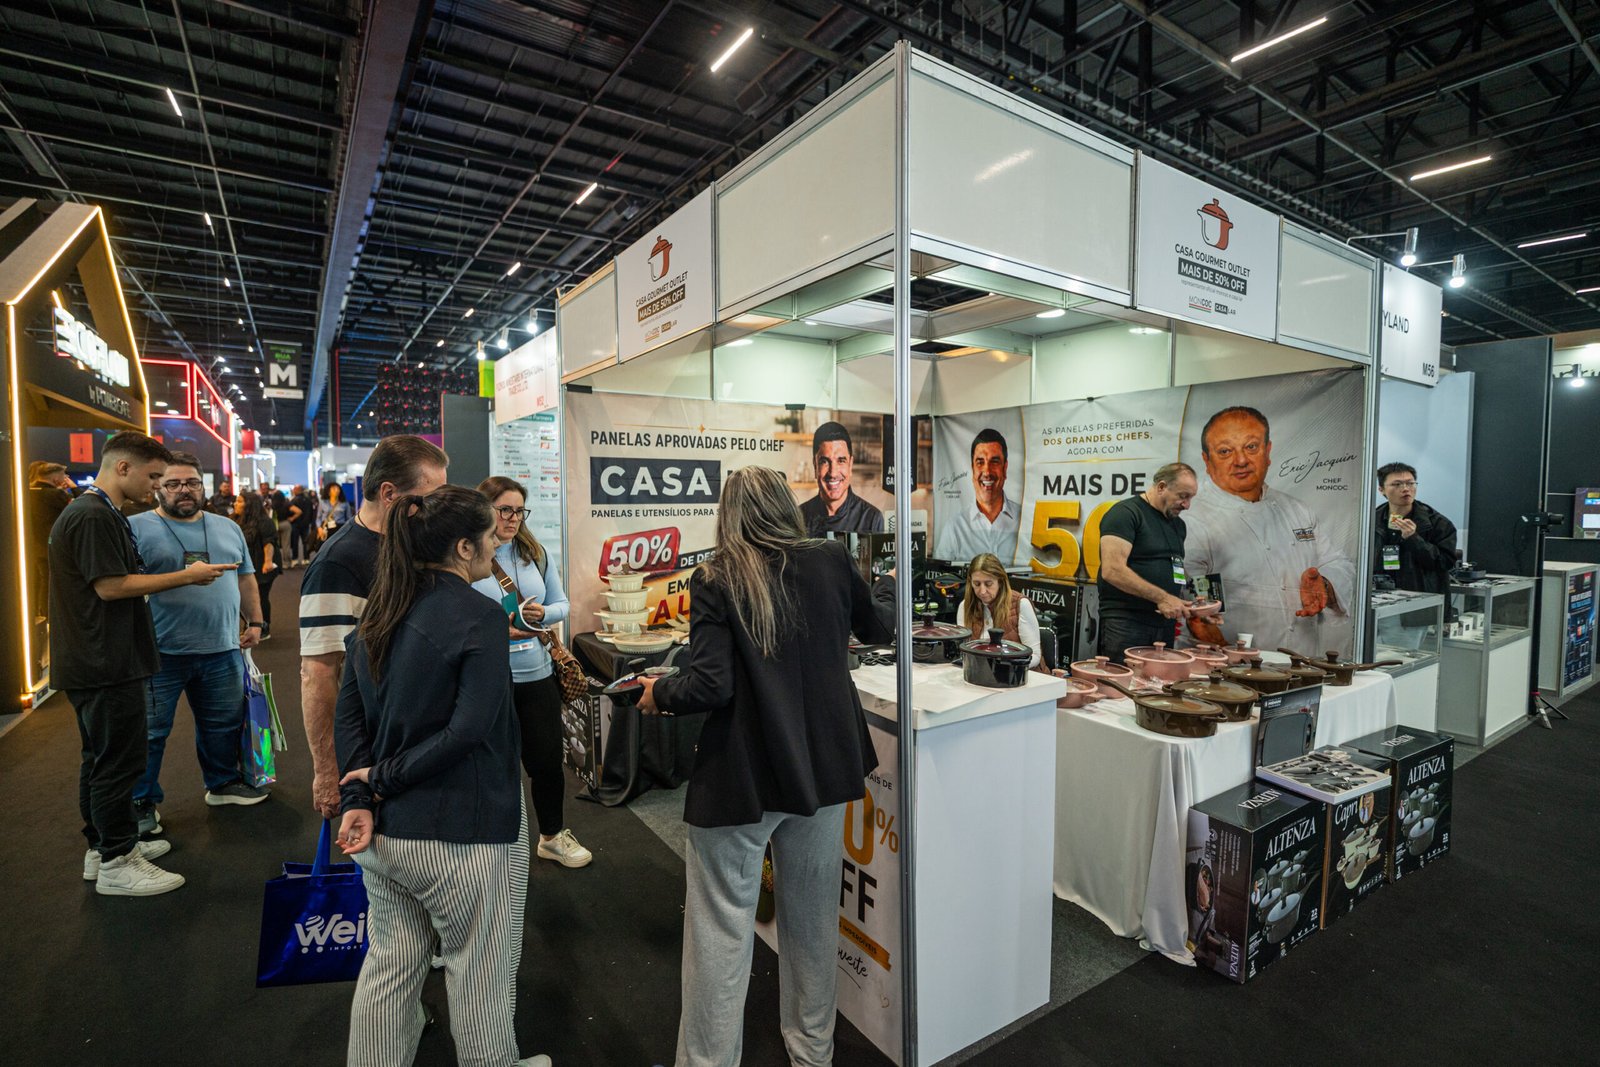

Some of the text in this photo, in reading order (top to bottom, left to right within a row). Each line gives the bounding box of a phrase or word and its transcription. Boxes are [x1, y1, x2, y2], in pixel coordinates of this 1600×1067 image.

[1174, 243, 1250, 278] CASA GOURMET OUTLET
[1180, 261, 1245, 292] MAIS DE 50% OFF
[636, 271, 688, 307] CASA GOURMET OUTLET
[640, 305, 652, 319] MAIS
[652, 301, 660, 312] DE
[660, 295, 672, 309] 50%
[672, 288, 684, 302] OFF
[270, 363, 297, 387] M
[1422, 362, 1435, 378] M56
[1042, 419, 1154, 436] AS PANELAS PREFERIDAS
[590, 430, 785, 452] PANELAS APROVADAS PELO CHEF
[1043, 438, 1062, 446] DOS
[1065, 434, 1112, 445] GRANDES
[1067, 445, 1124, 456] AGORA COM
[1279, 451, 1357, 484] Eric Jacquin
[600, 465, 713, 496] CASA
[1043, 473, 1146, 496] MAIS DE
[591, 509, 633, 518] PANELAS
[635, 509, 640, 517] E
[642, 507, 691, 517] UTENSÍLIOS
[693, 508, 714, 516] PARA
[607, 533, 672, 575] 50%
[680, 556, 694, 568] DE
[667, 577, 689, 595] EM
[1020, 588, 1066, 608] ALTENZA
[1407, 755, 1446, 786] ALTENZA
[883, 779, 893, 790] DE
[1238, 788, 1282, 810] ALTENZA
[1335, 800, 1358, 831] Capri
[1264, 816, 1316, 861] ALTENZA
[1229, 940, 1240, 978] ALTENZA
